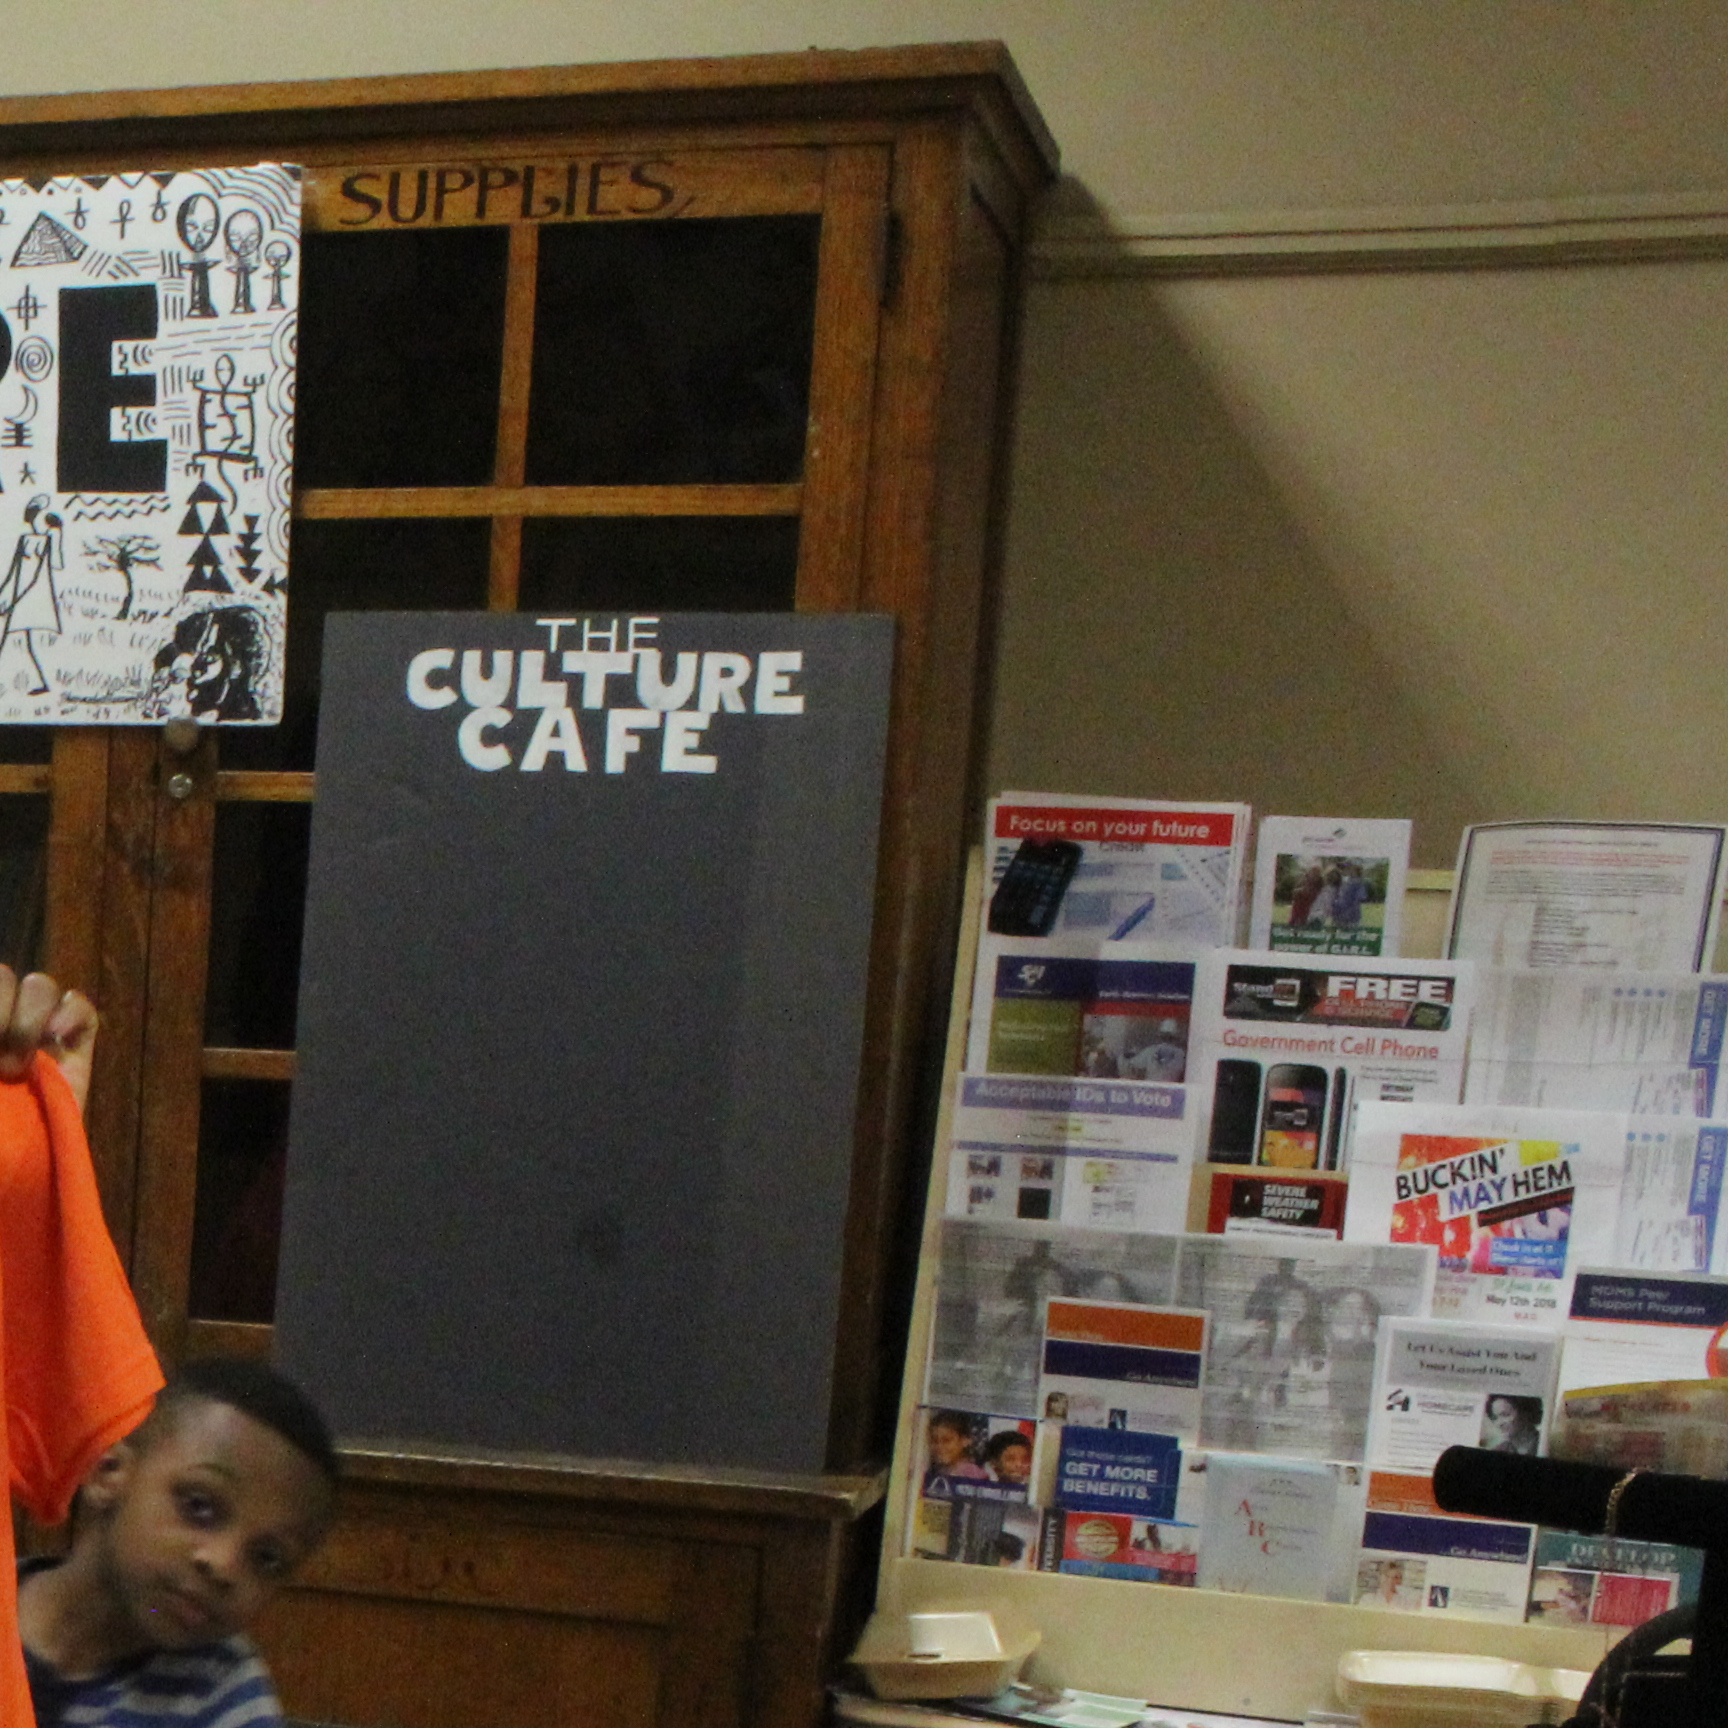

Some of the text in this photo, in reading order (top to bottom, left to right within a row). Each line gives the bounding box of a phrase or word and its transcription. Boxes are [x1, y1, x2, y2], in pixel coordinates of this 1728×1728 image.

[339, 158, 678, 227] SUPPLIES
[536, 617, 660, 655] THE
[405, 648, 805, 716] CULTURE
[456, 705, 718, 775] CAFE
[1009, 815, 1211, 839] Focus on your future
[1327, 975, 1448, 1002] FREE
[1222, 1029, 1440, 1060] Government Cell Phone
[1110, 1090, 1128, 1104] to
[1132, 1090, 1172, 1108] Vote
[1395, 1149, 1506, 1201] BUCKIN'
[1261, 1207, 1304, 1221] SAFETY
[1065, 1461, 1159, 1484] GET MORE
